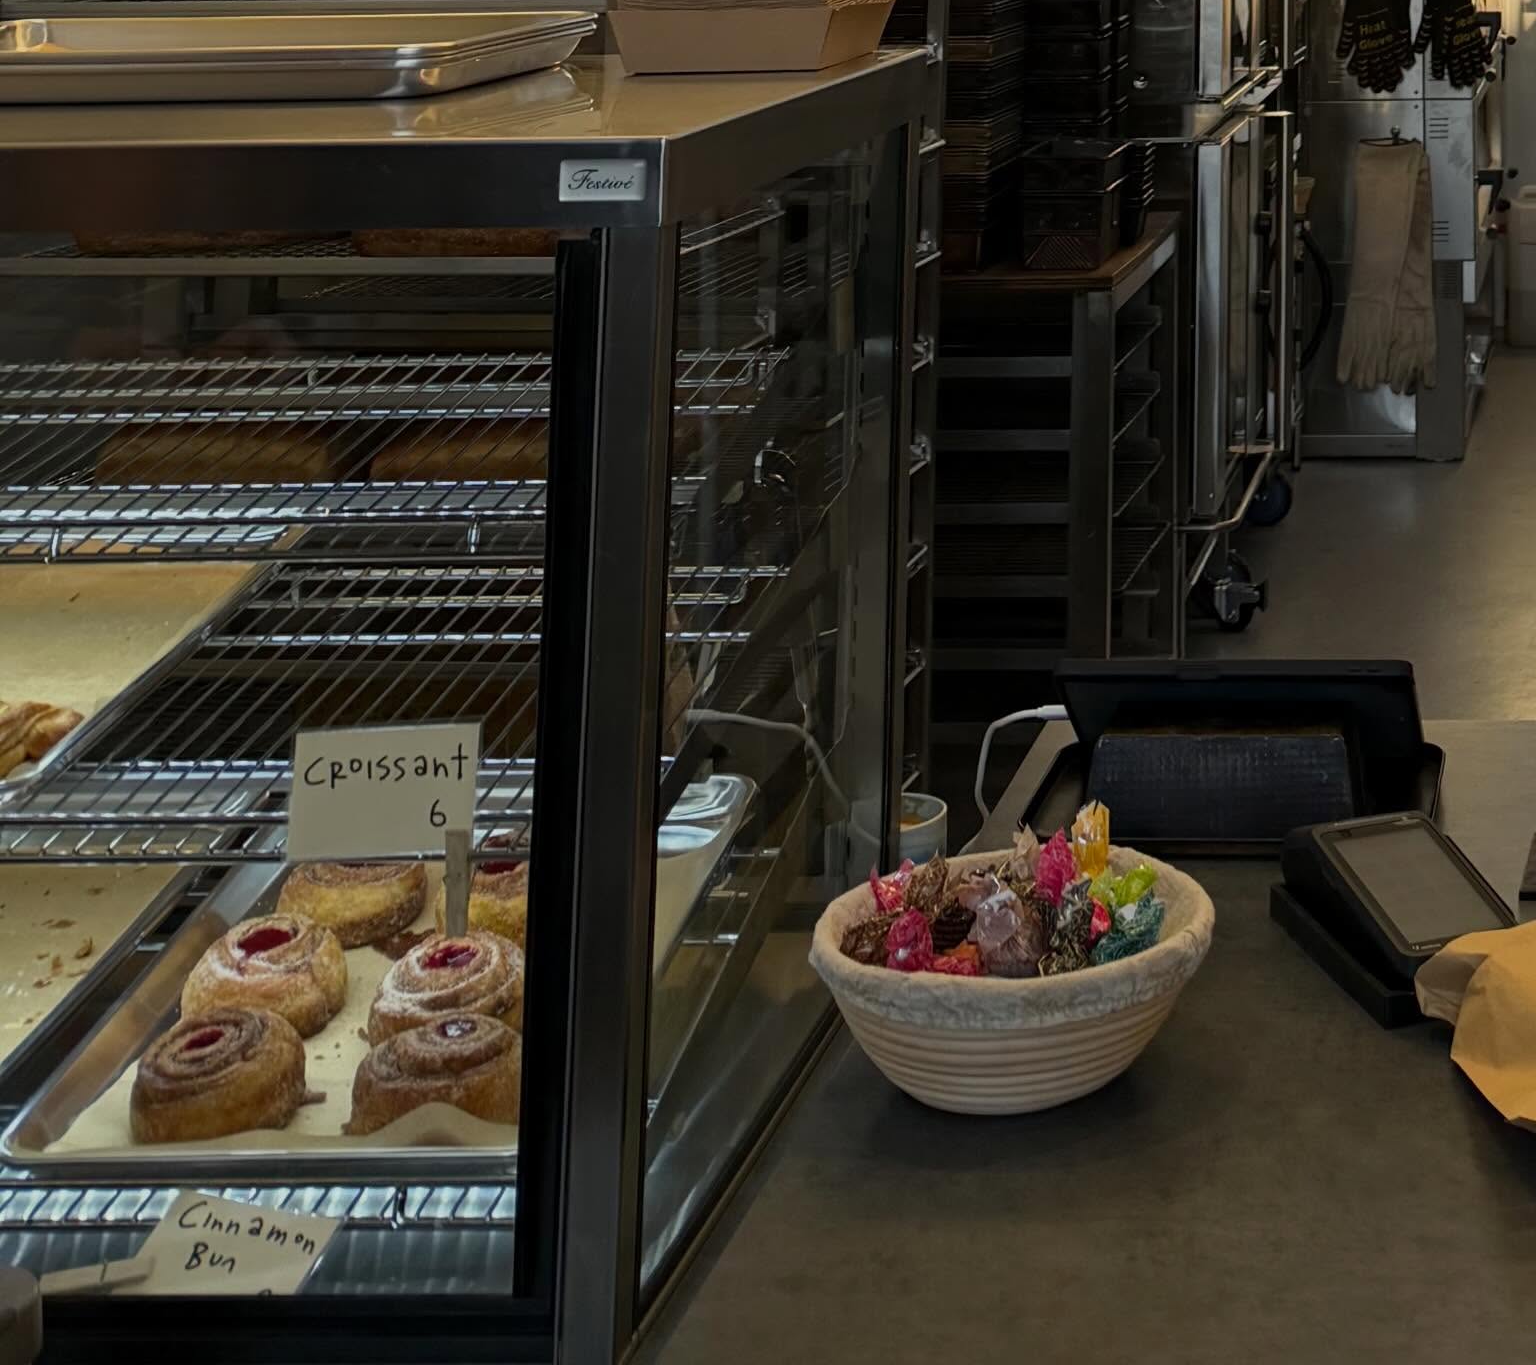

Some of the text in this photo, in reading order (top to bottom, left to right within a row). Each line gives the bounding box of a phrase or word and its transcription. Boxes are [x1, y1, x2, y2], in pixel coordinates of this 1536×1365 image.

[429, 798, 448, 828] 6
[178, 1200, 316, 1256] Cinnamon
[184, 1240, 236, 1274] Bun
